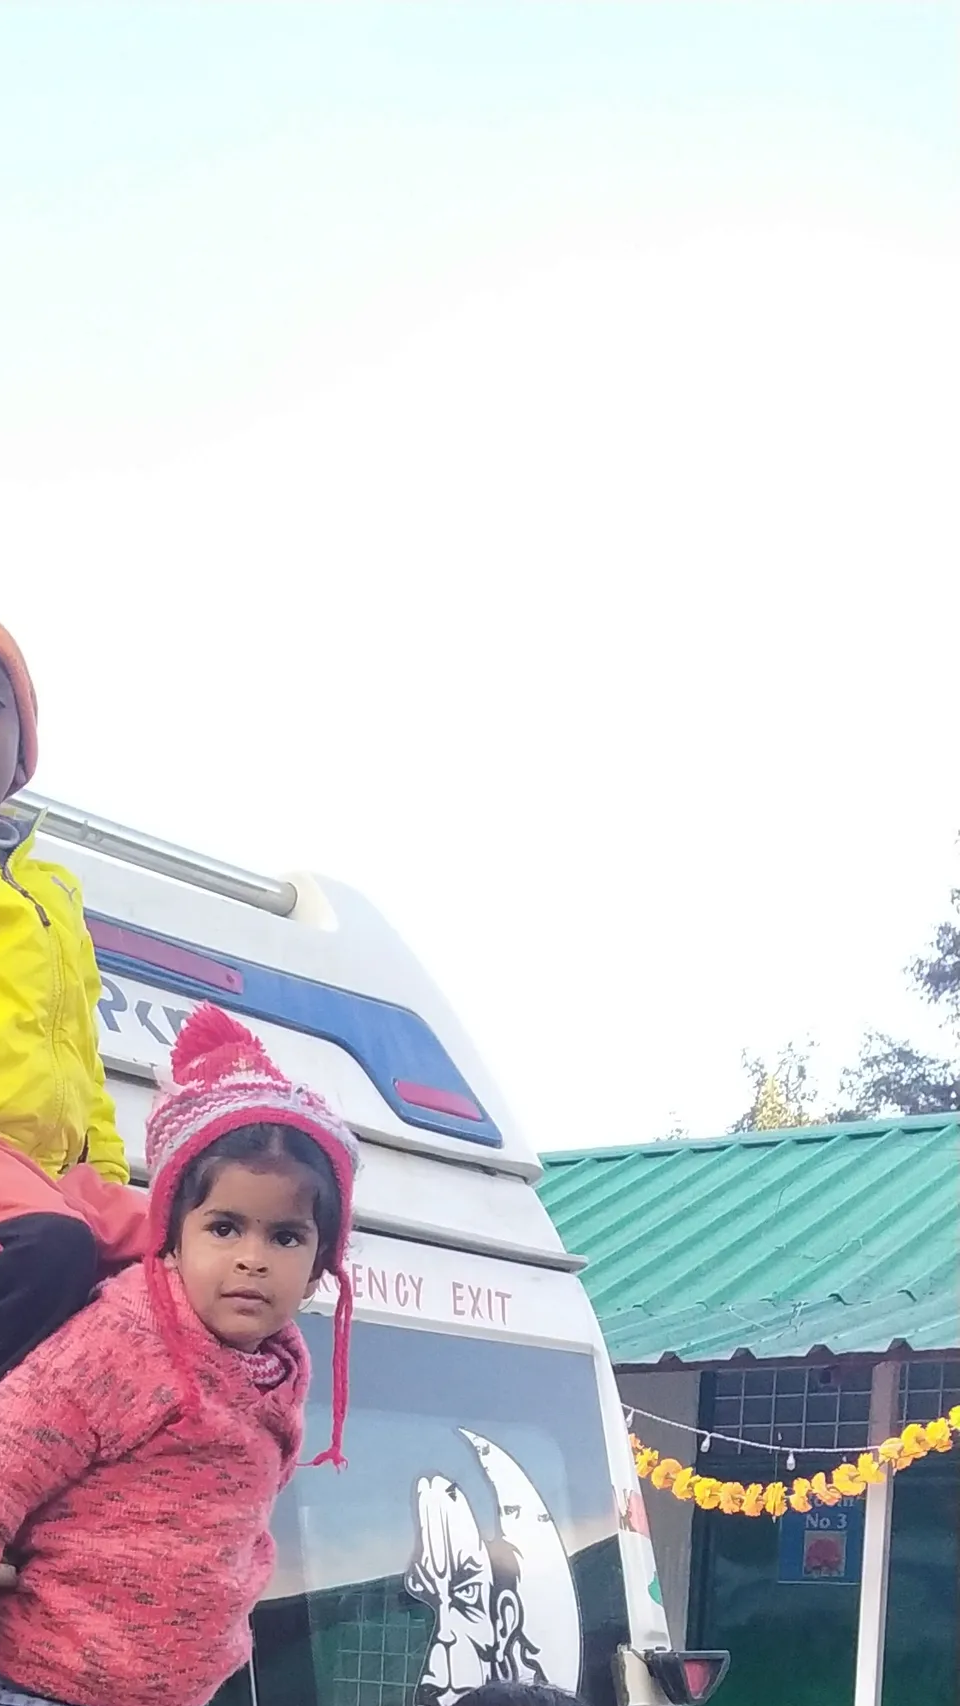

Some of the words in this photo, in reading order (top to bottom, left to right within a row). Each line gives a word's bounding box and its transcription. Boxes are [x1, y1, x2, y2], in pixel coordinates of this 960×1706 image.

[451, 1280, 513, 1326] EXIT
[804, 1513, 832, 1529] No
[836, 1513, 848, 1529] 3
